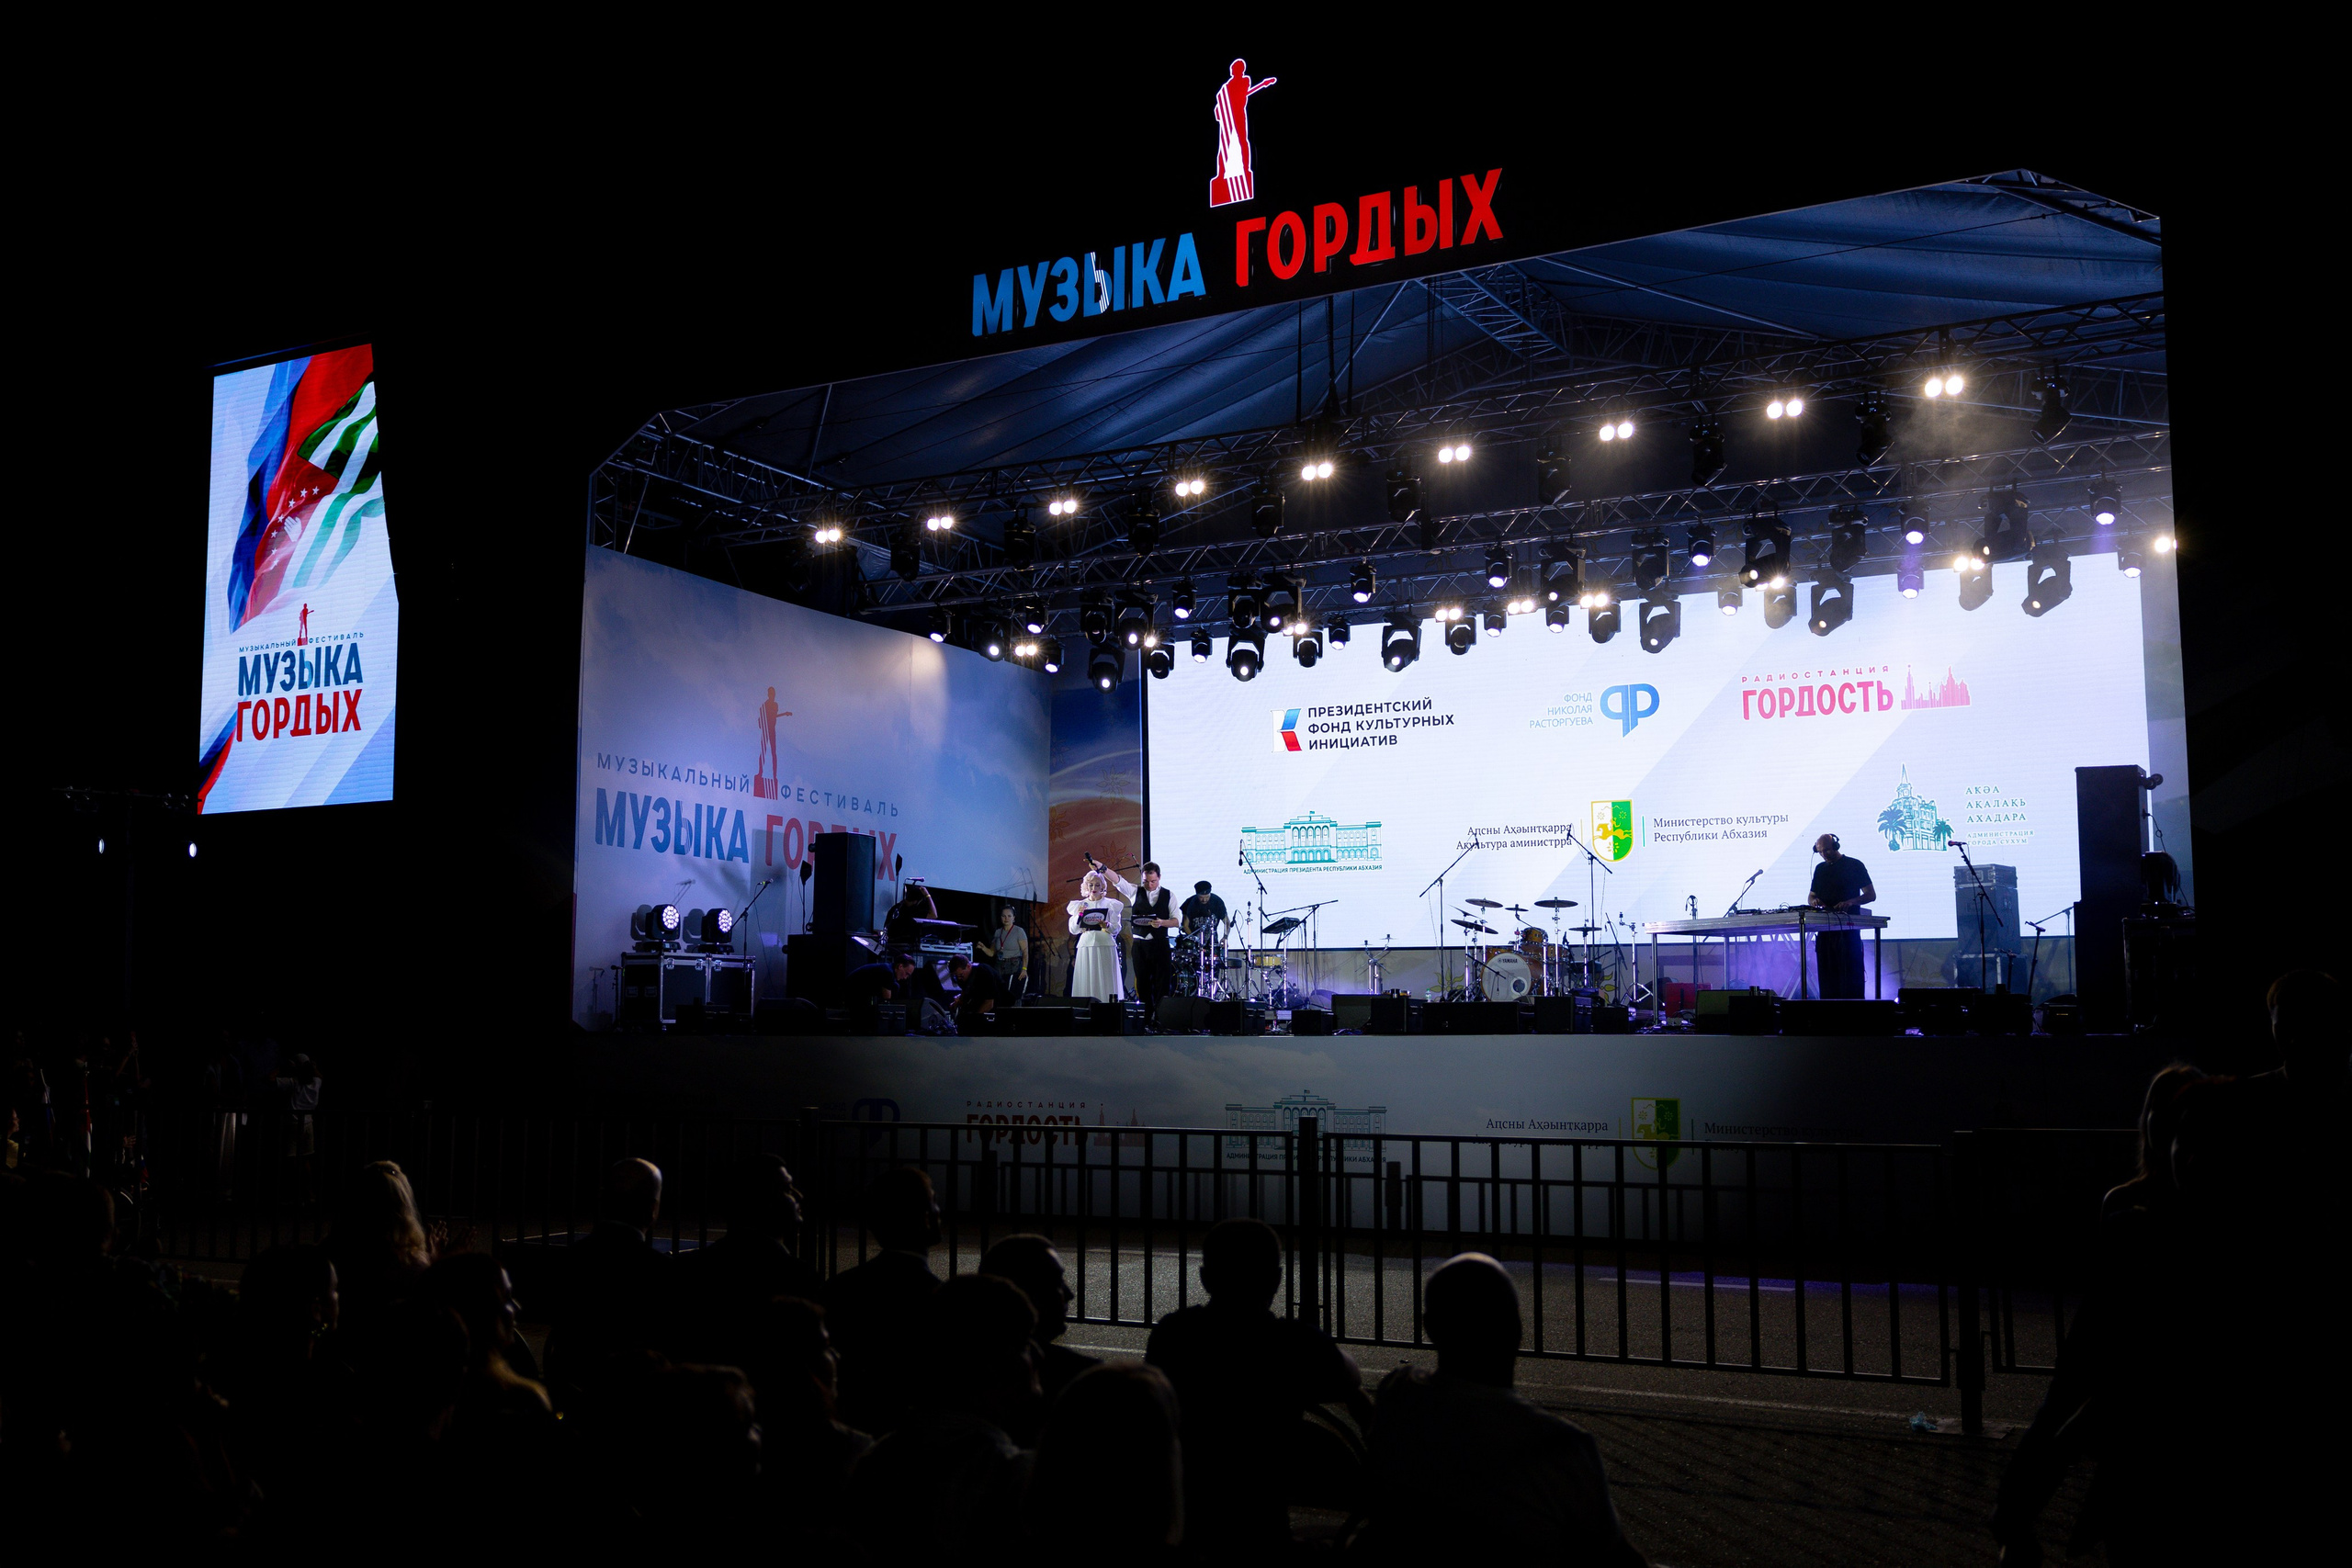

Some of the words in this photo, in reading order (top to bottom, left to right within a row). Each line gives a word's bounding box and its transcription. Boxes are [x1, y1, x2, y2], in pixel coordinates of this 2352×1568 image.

[972, 232, 1206, 337] МУЗЫКА
[1236, 168, 1503, 287] ГОРДЫХ
[239, 638, 297, 652] МУЗЫКАЛЬНЫЙ
[309, 632, 364, 644] ФЕСТИВАЛЬ
[238, 642, 363, 696] МУЗЫКА
[1742, 665, 1889, 682] РАДИОСТАНЦИЯ
[1308, 696, 1432, 717] ПРЕЗИДЕНТСКИЙ
[1564, 693, 1592, 703] ФОНД
[1742, 680, 1894, 720] ГОРДОСТЬ
[236, 689, 362, 742] ГОРДЫХ
[1547, 705, 1592, 716] НИКОЛАЯ
[1308, 721, 1351, 734] ФОНД
[1356, 714, 1454, 731] КУЛЬТУРНЫХ
[1530, 716, 1593, 728] РАСТОРГУЕВА
[1308, 735, 1397, 750] ИНИЦИАТИВ
[597, 752, 749, 793] МУЗЫКАЛЬНЫЙ
[781, 784, 898, 817] ФЕСТИВАЛЬ
[1654, 817, 1733, 828] Министерство
[1736, 814, 1789, 826] культуры
[1967, 813, 2026, 823] АХАДАРА
[595, 787, 749, 863] МУЗЫКА
[764, 814, 897, 882] ГОРХ
[1654, 829, 1718, 843] Республики
[1722, 829, 1768, 840] Абхазия
[1704, 1122, 1798, 1137] Министерство
